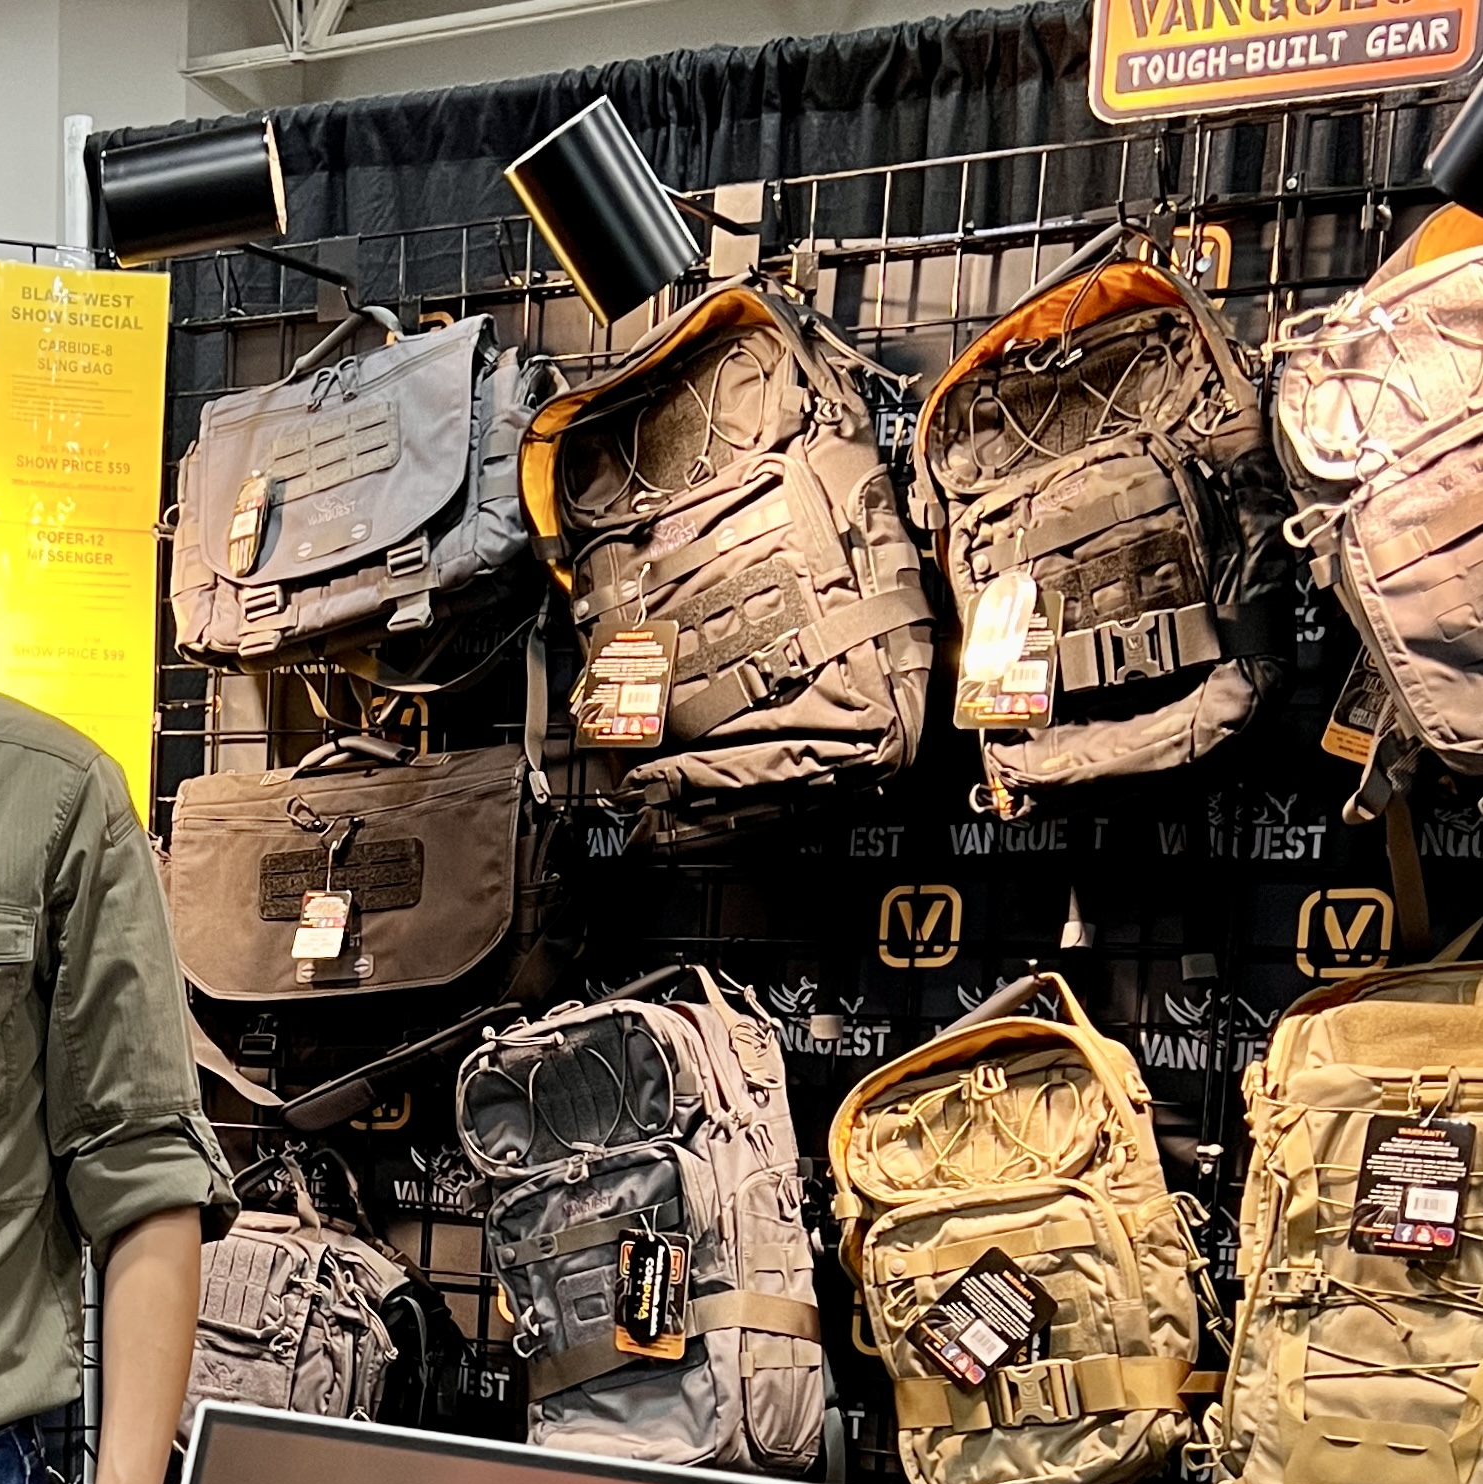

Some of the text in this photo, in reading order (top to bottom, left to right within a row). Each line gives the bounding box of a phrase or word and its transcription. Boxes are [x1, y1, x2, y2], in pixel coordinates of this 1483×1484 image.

[1127, 17, 1450, 87] TOUGH-BUILT GEAR
[83, 292, 135, 309] WEST
[11, 306, 144, 330] SHOW SPECIAL
[38, 337, 113, 357] CARBIDE-8
[82, 361, 114, 376] BAG
[16, 454, 131, 475] SHOW PRICE $59
[637, 1256, 655, 1320] CORDURA
